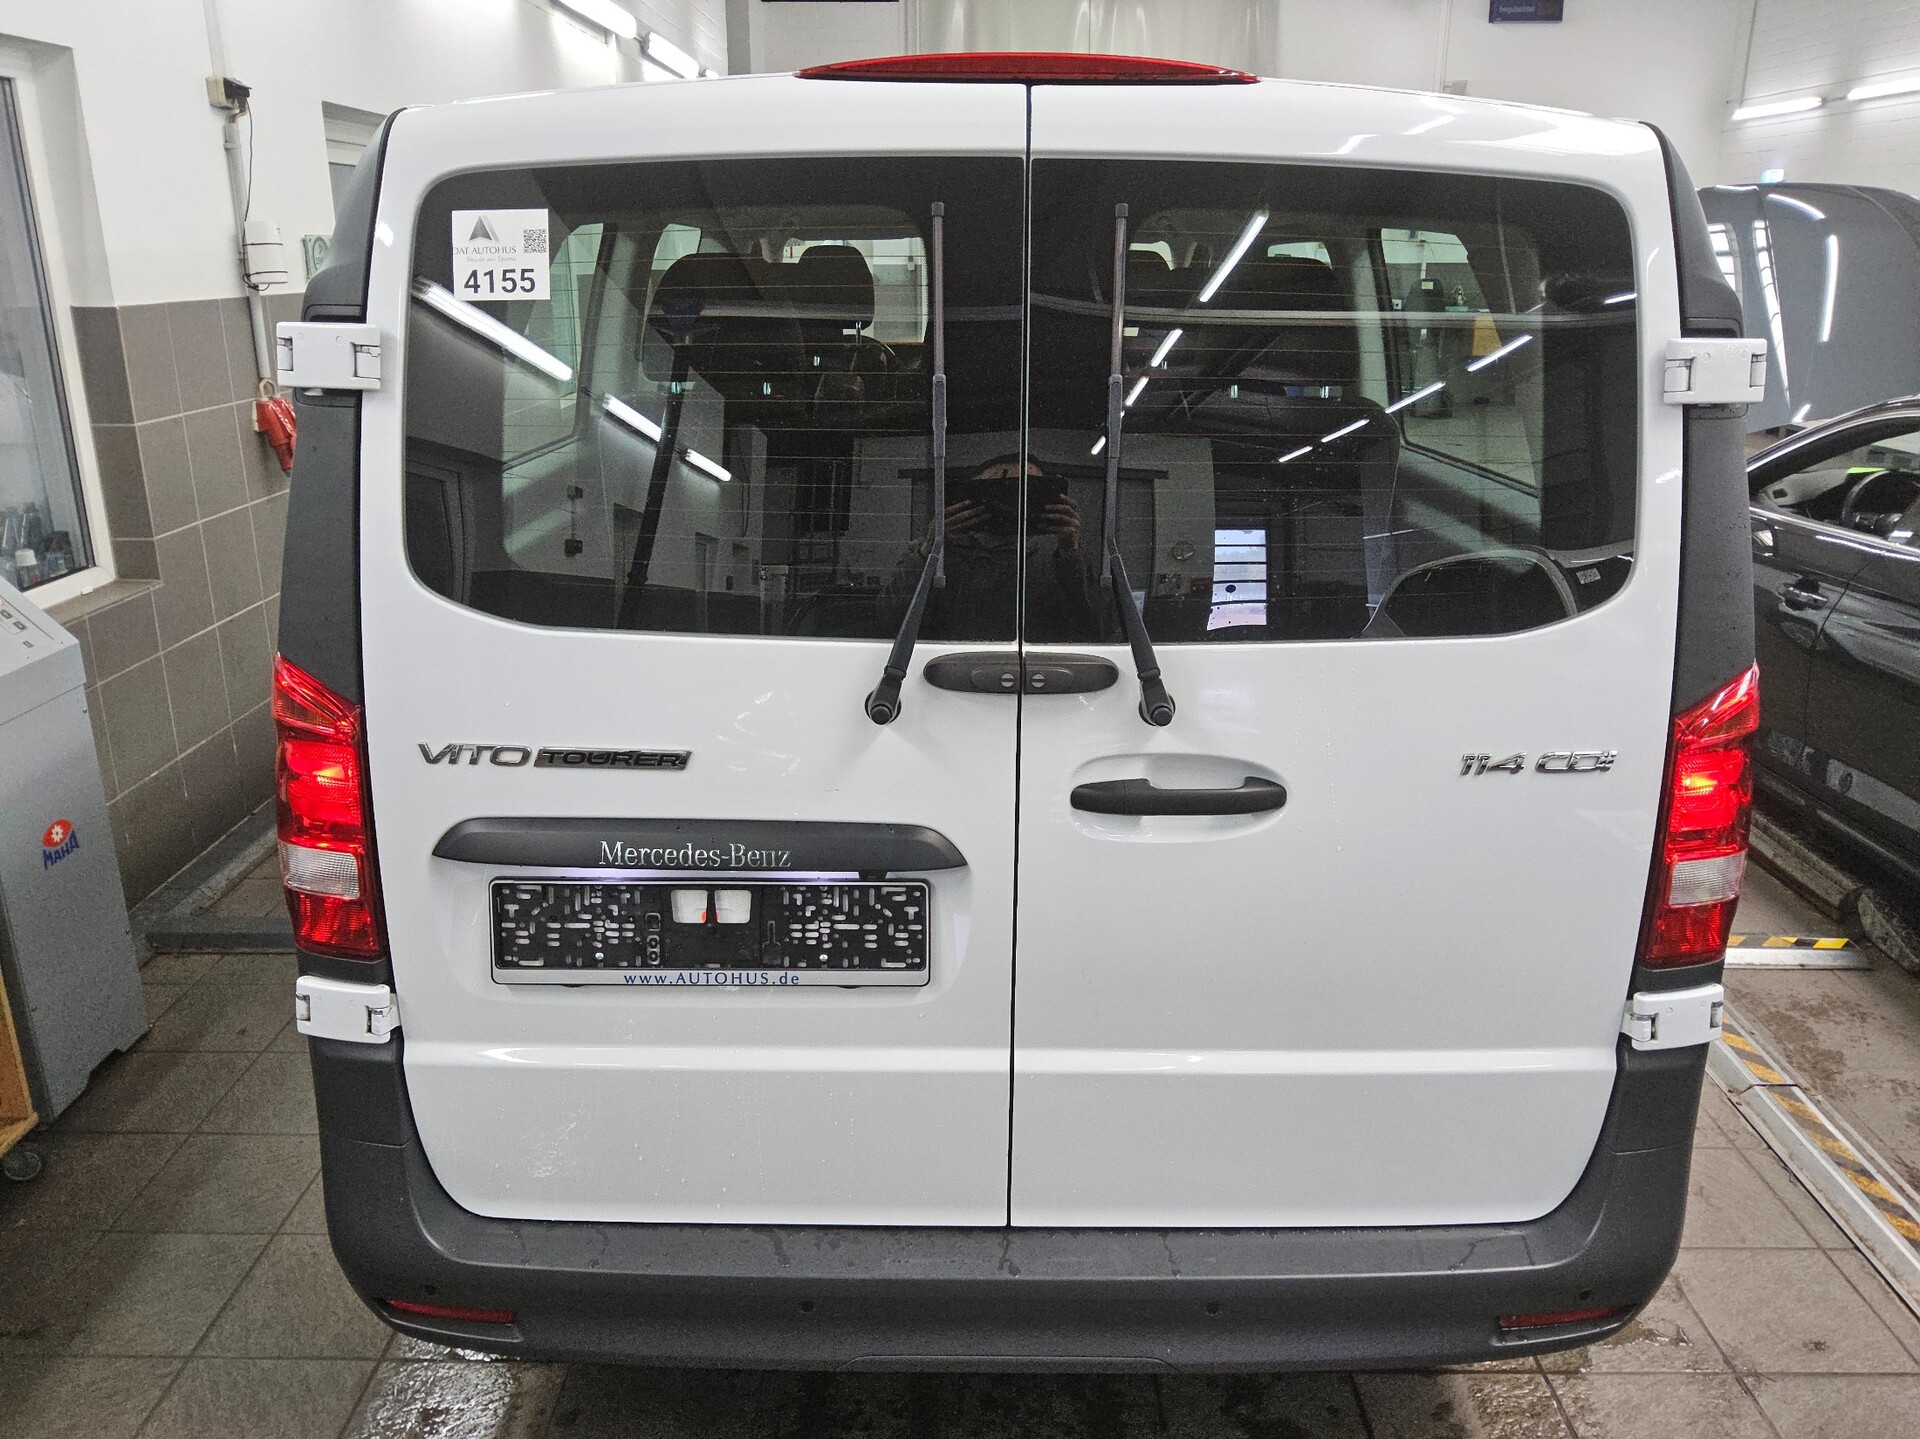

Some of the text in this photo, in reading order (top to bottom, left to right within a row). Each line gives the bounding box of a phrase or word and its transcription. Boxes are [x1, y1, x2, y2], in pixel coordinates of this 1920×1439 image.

[472, 246, 517, 254] AUTOHUS
[464, 269, 536, 294] 4155
[418, 743, 688, 769] VITO TOURER
[1460, 751, 1527, 776] 114
[42, 829, 80, 870] MAHA
[599, 840, 792, 868] Mercedes-Benz
[624, 972, 800, 985] www.AUTOHUS.de
